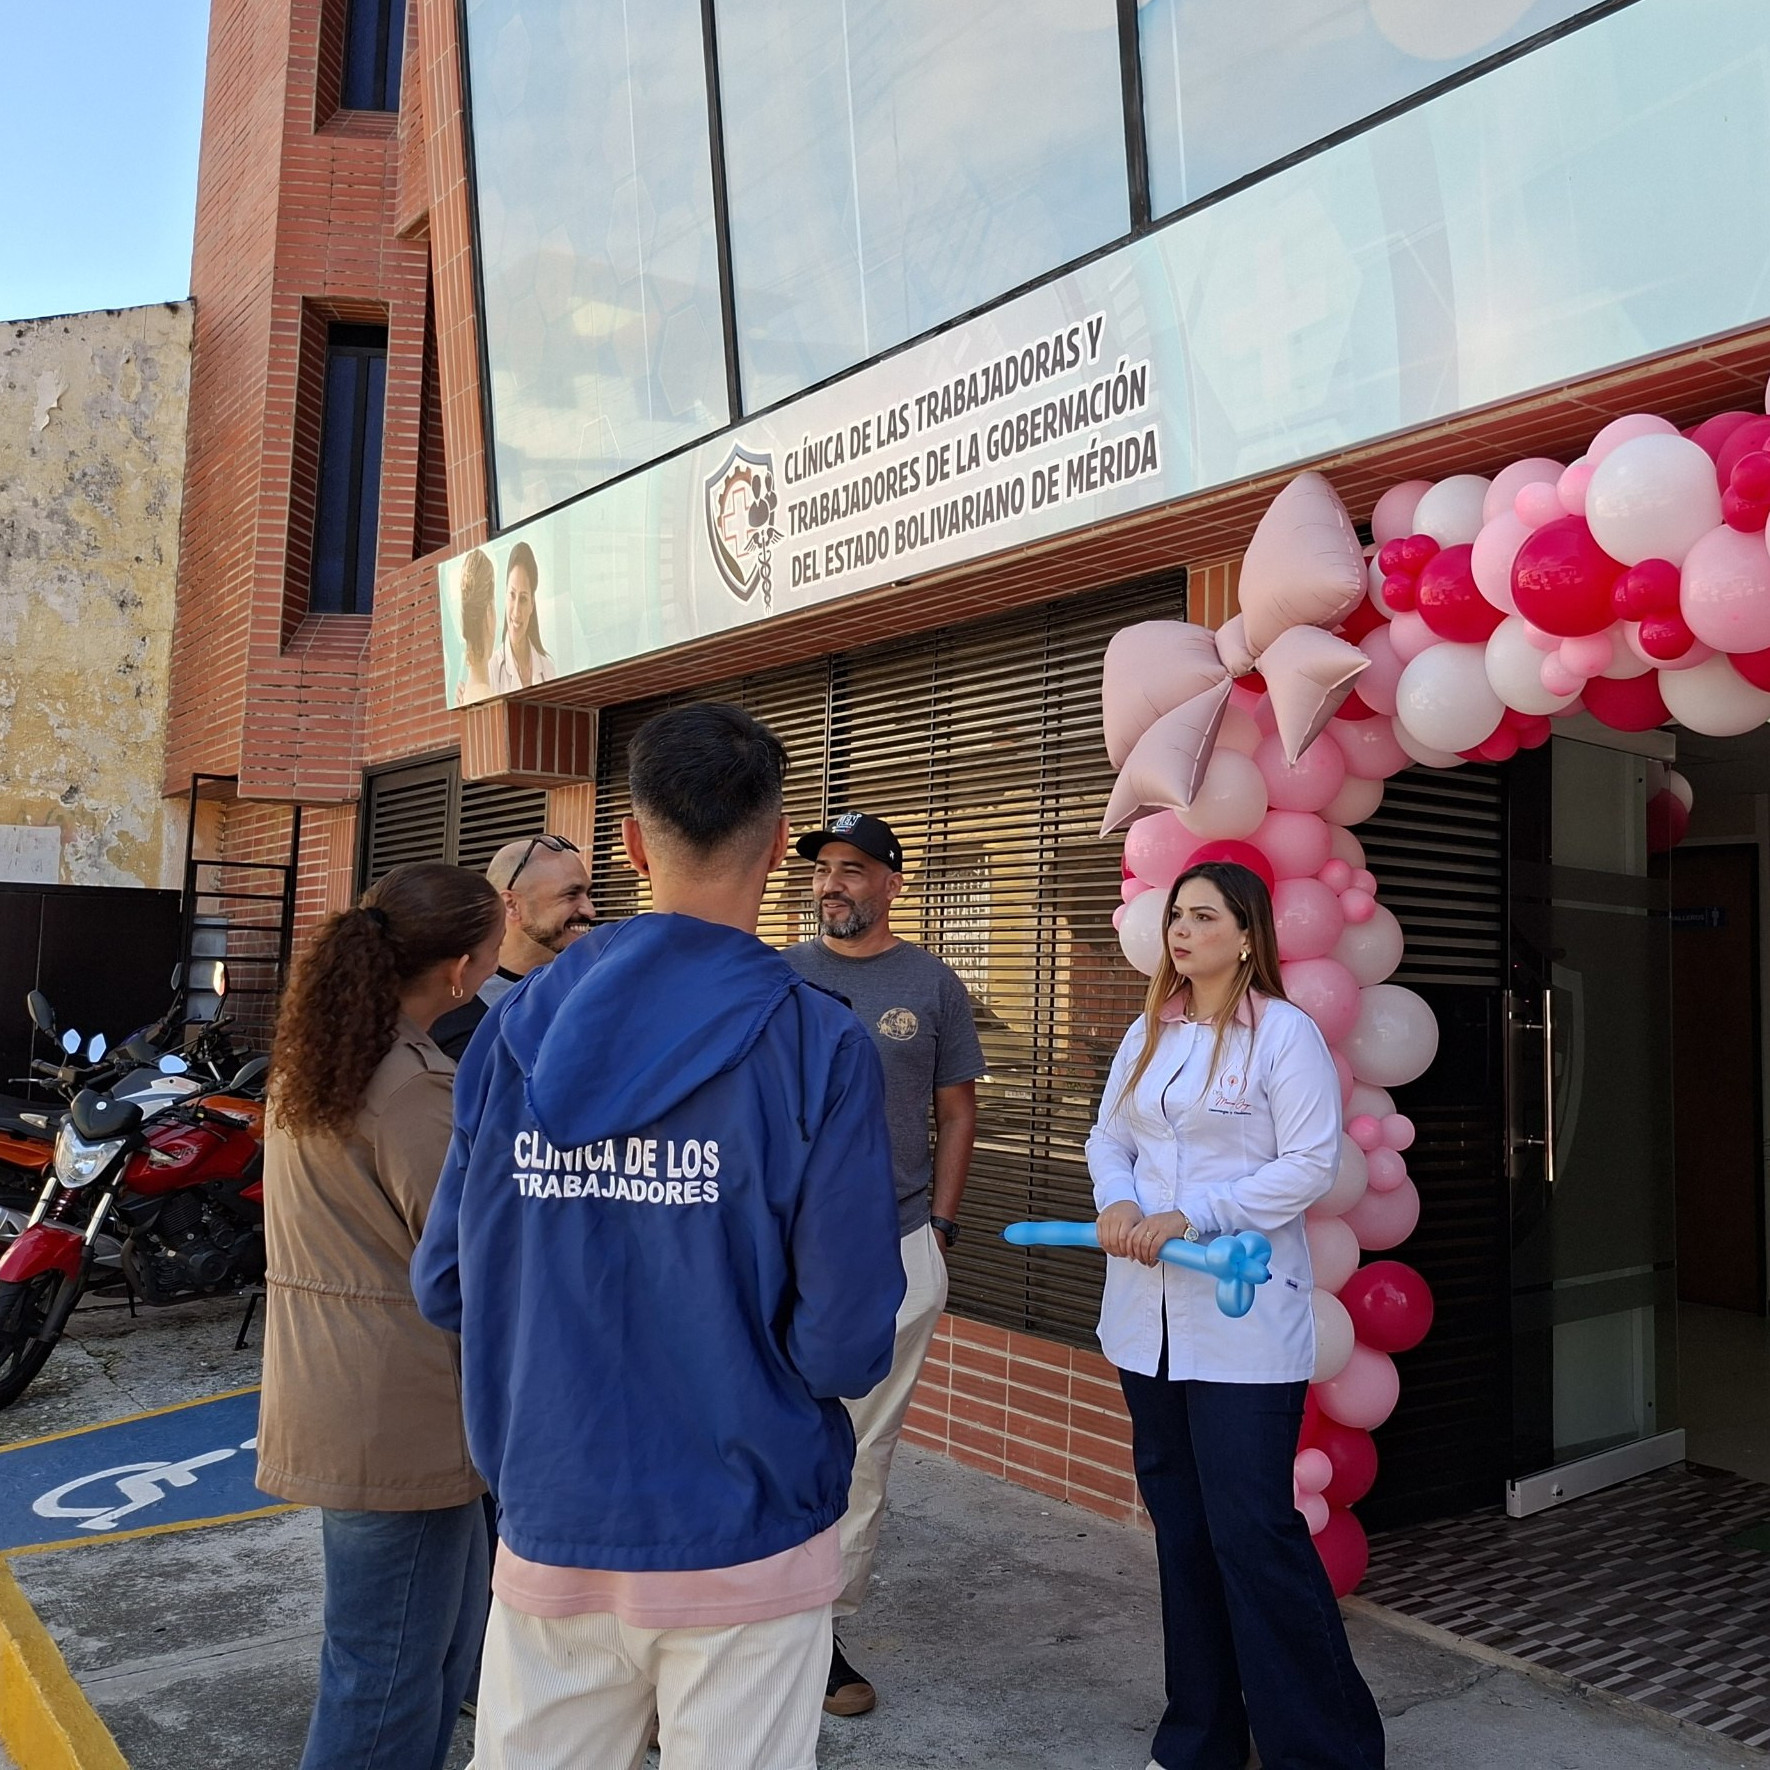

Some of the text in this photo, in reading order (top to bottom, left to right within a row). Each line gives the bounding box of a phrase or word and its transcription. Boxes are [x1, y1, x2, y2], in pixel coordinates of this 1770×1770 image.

[784, 316, 1103, 485] CLÍNICA DE LAS TRABAJADORAS Y
[788, 360, 1145, 536] TRABAJADORES DE LA GOBERNACIÓN
[792, 430, 1158, 588] DEL ESTADO BOLIVARIANO DE MÉRIDA
[512, 1172, 720, 1206] TRABAJADORES
[624, 1137, 658, 1179] DE
[666, 1138, 720, 1179] LOS
